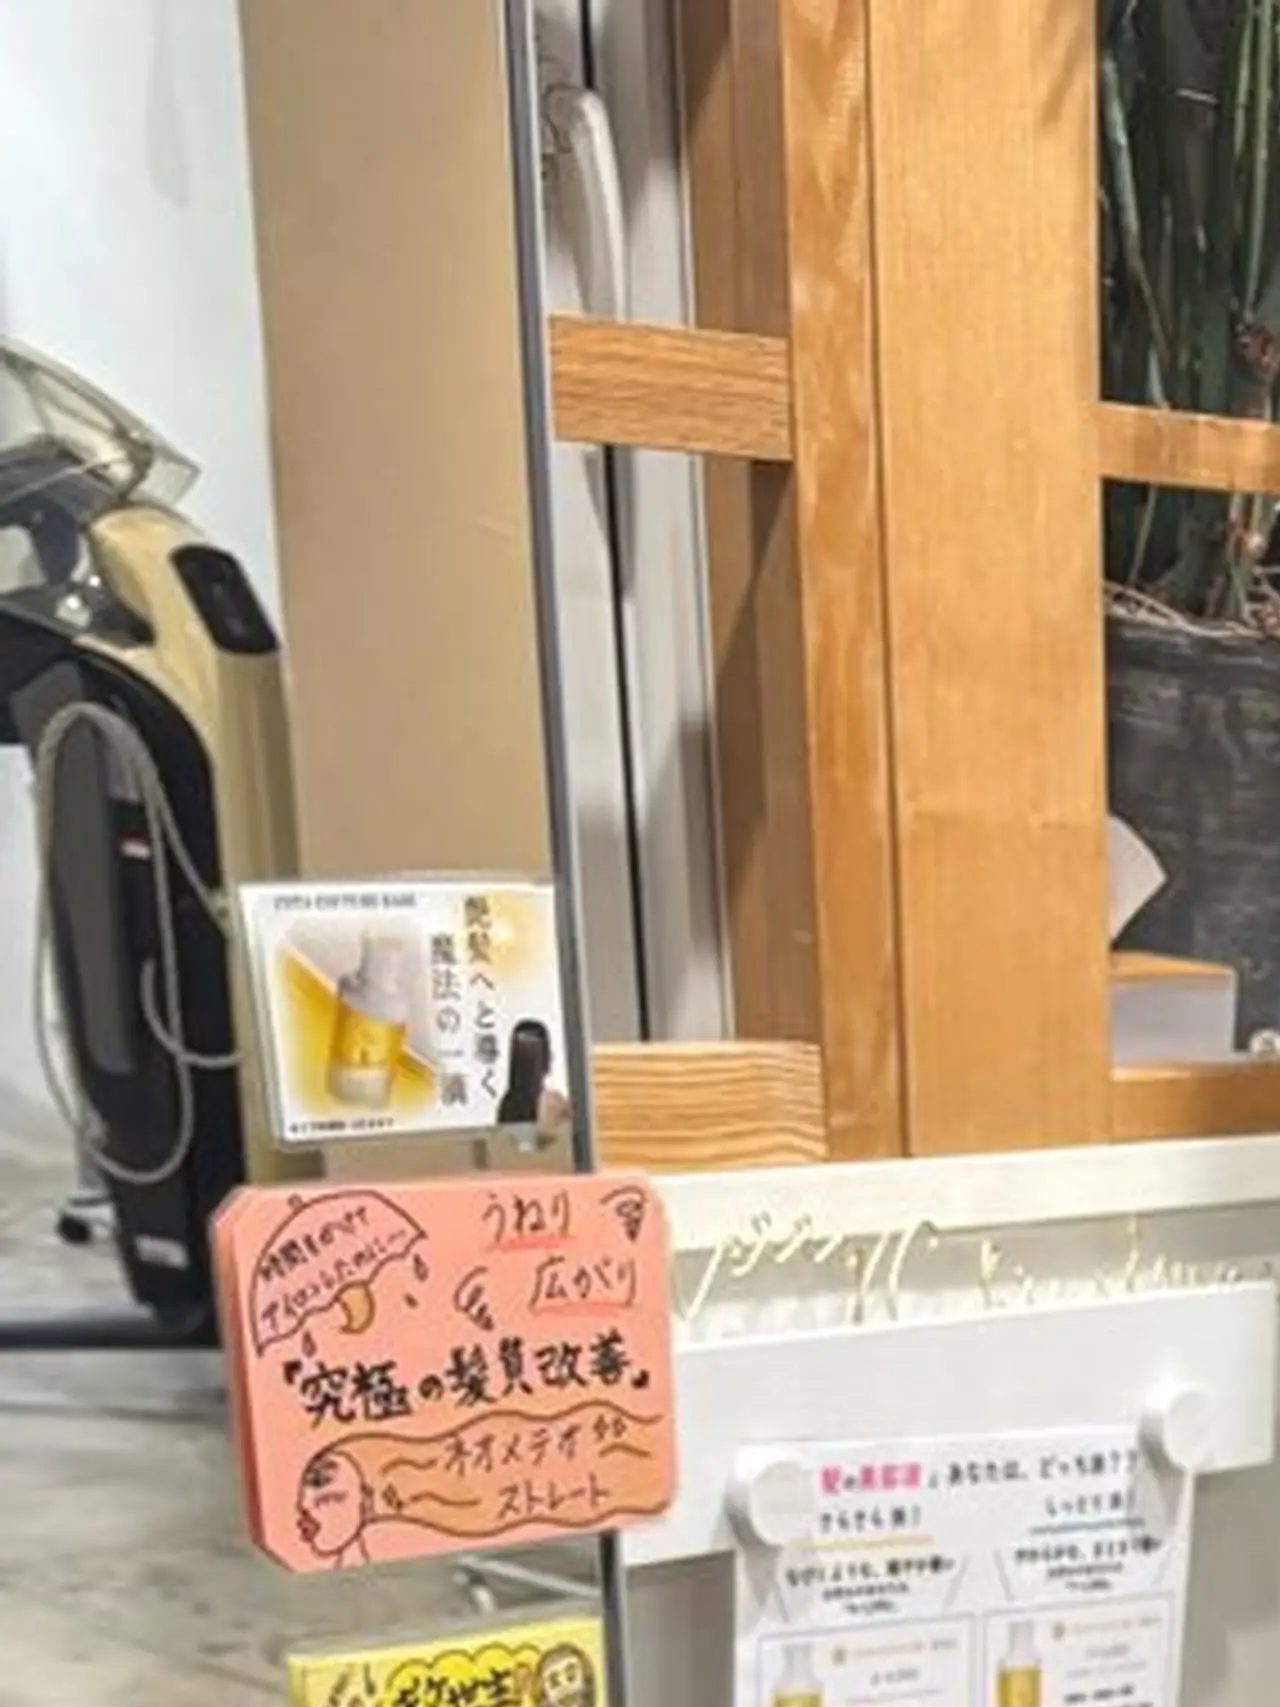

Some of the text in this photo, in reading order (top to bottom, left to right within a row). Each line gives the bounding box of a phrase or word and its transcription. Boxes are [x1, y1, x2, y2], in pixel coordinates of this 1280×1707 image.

[431, 933, 468, 1106] 魔法の一滴
[482, 1192, 571, 1245] うねり
[530, 1256, 638, 1311] 広がり
[498, 1472, 610, 1519] ストレート
